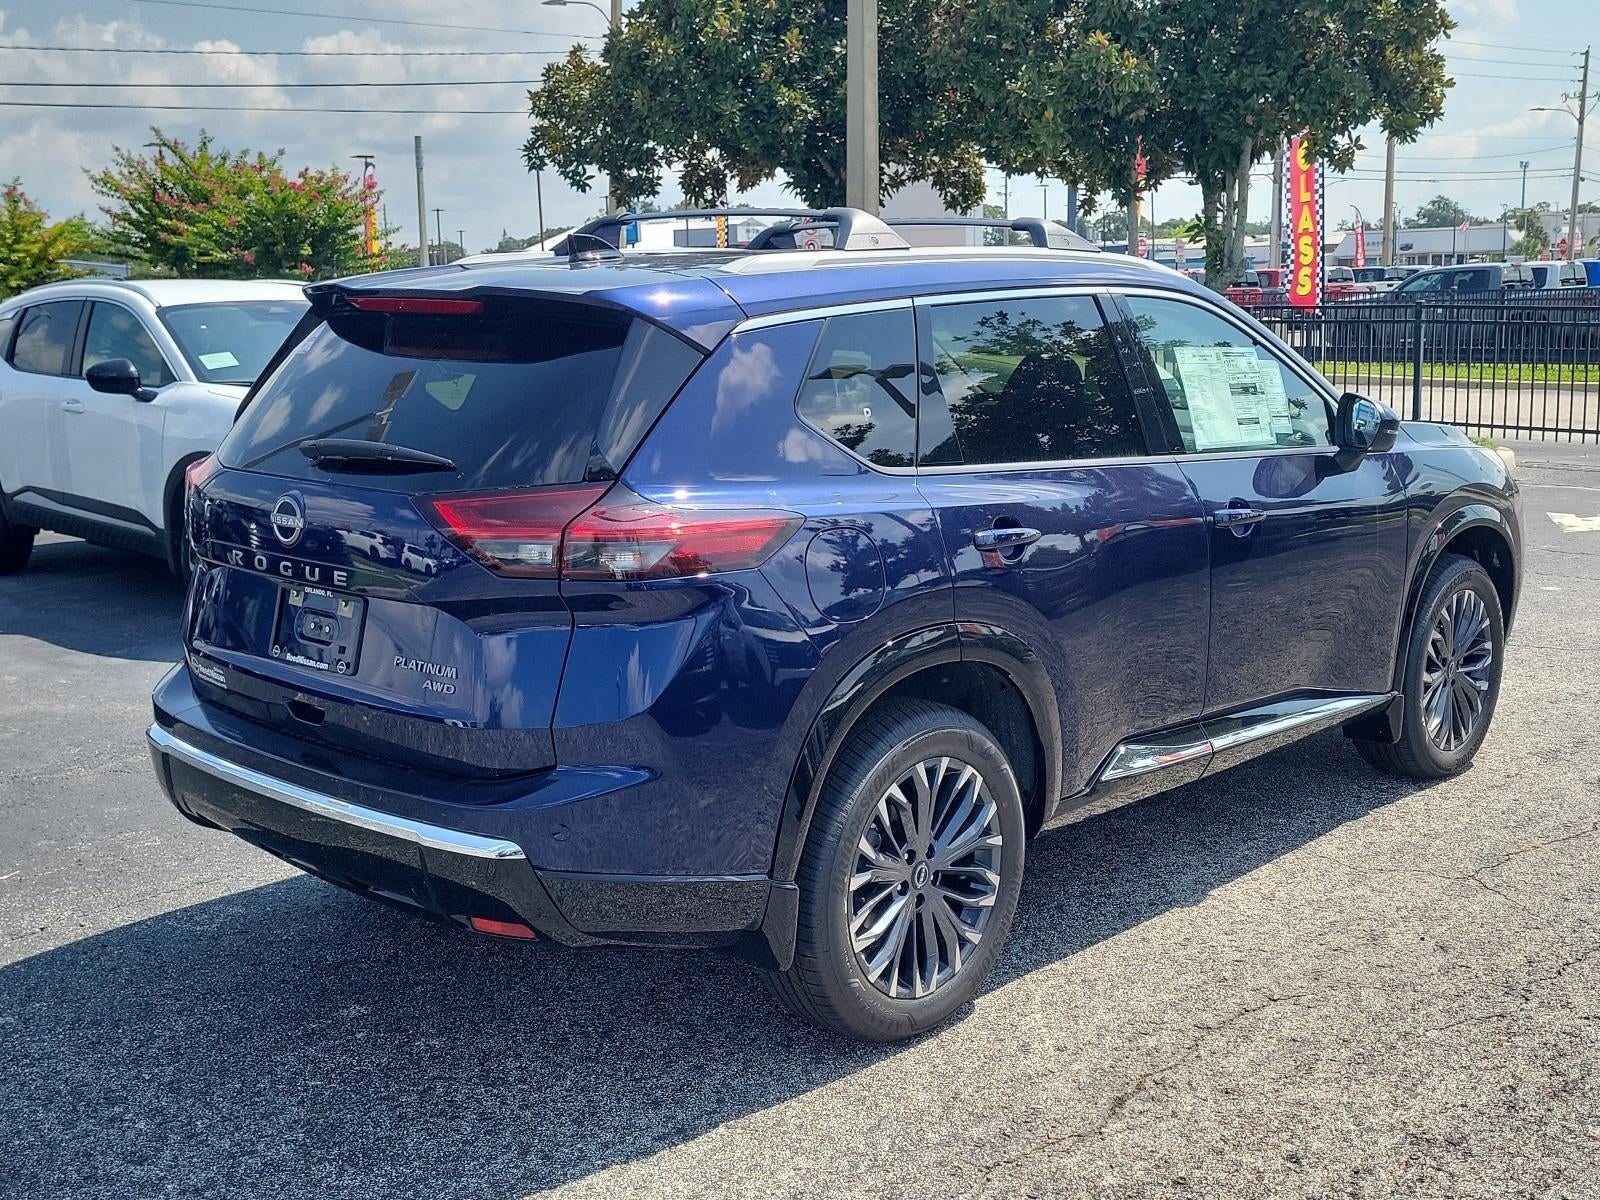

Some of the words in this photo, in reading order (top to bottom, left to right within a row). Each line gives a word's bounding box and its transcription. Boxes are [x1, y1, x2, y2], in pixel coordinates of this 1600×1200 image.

[271, 512, 303, 528] NISSAN
[231, 549, 348, 587] ROGUE
[393, 655, 458, 679] PLATINUM
[422, 679, 456, 695] AWD
